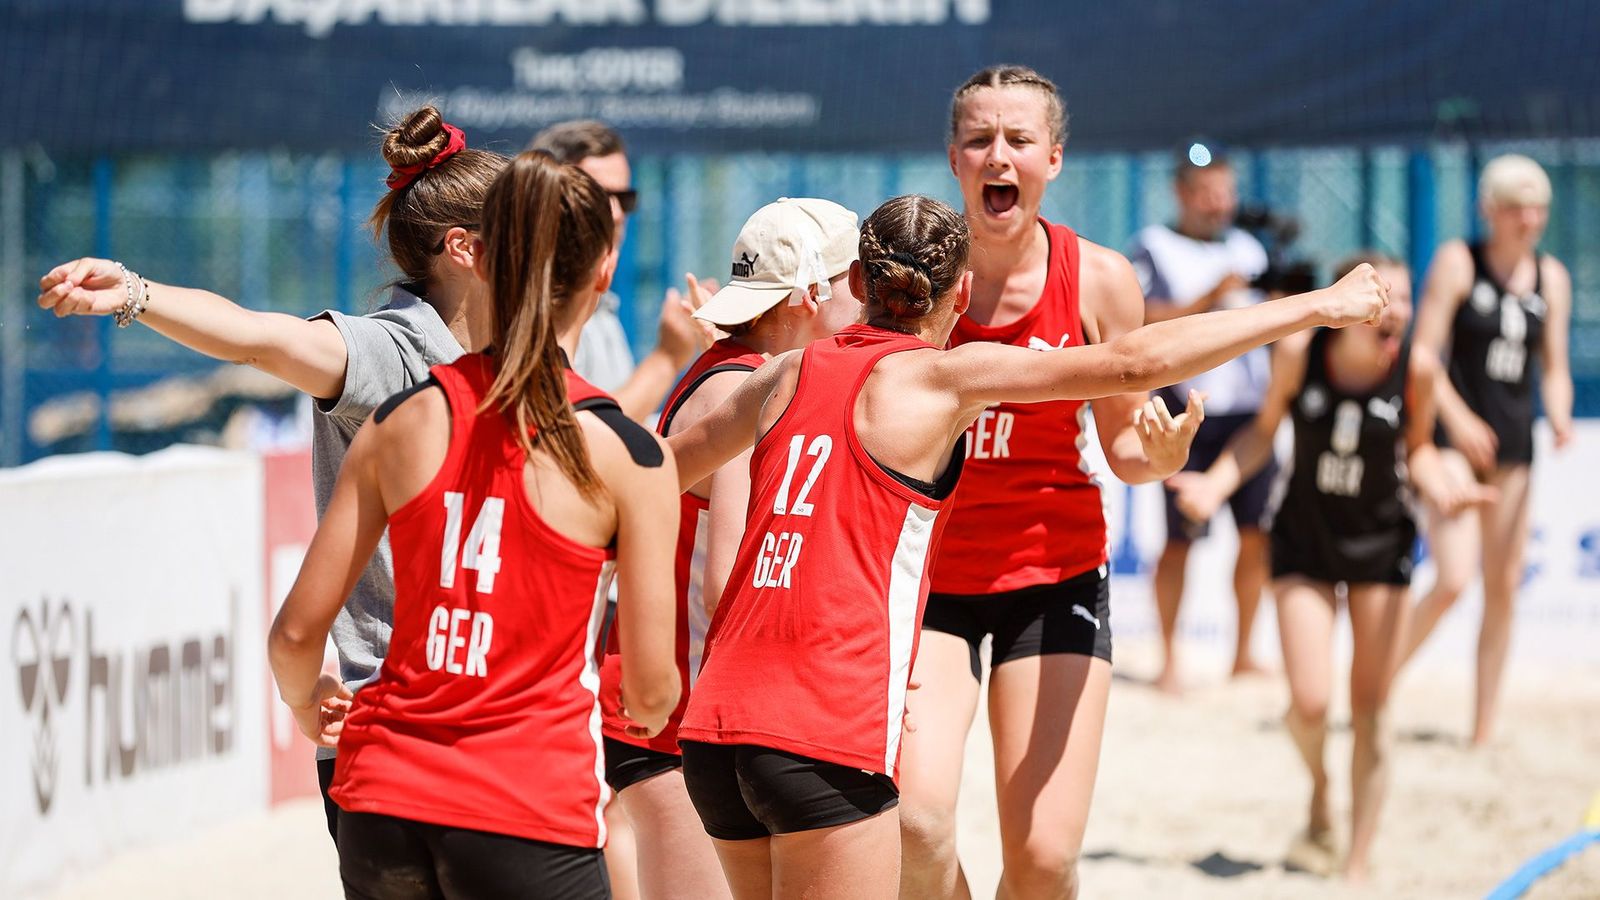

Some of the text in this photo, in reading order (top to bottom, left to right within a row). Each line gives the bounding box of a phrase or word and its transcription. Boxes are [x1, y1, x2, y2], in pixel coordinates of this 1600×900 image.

[773, 434, 832, 517] 12
[440, 491, 505, 594] 14
[752, 532, 803, 589] GER
[426, 605, 494, 678] GER
